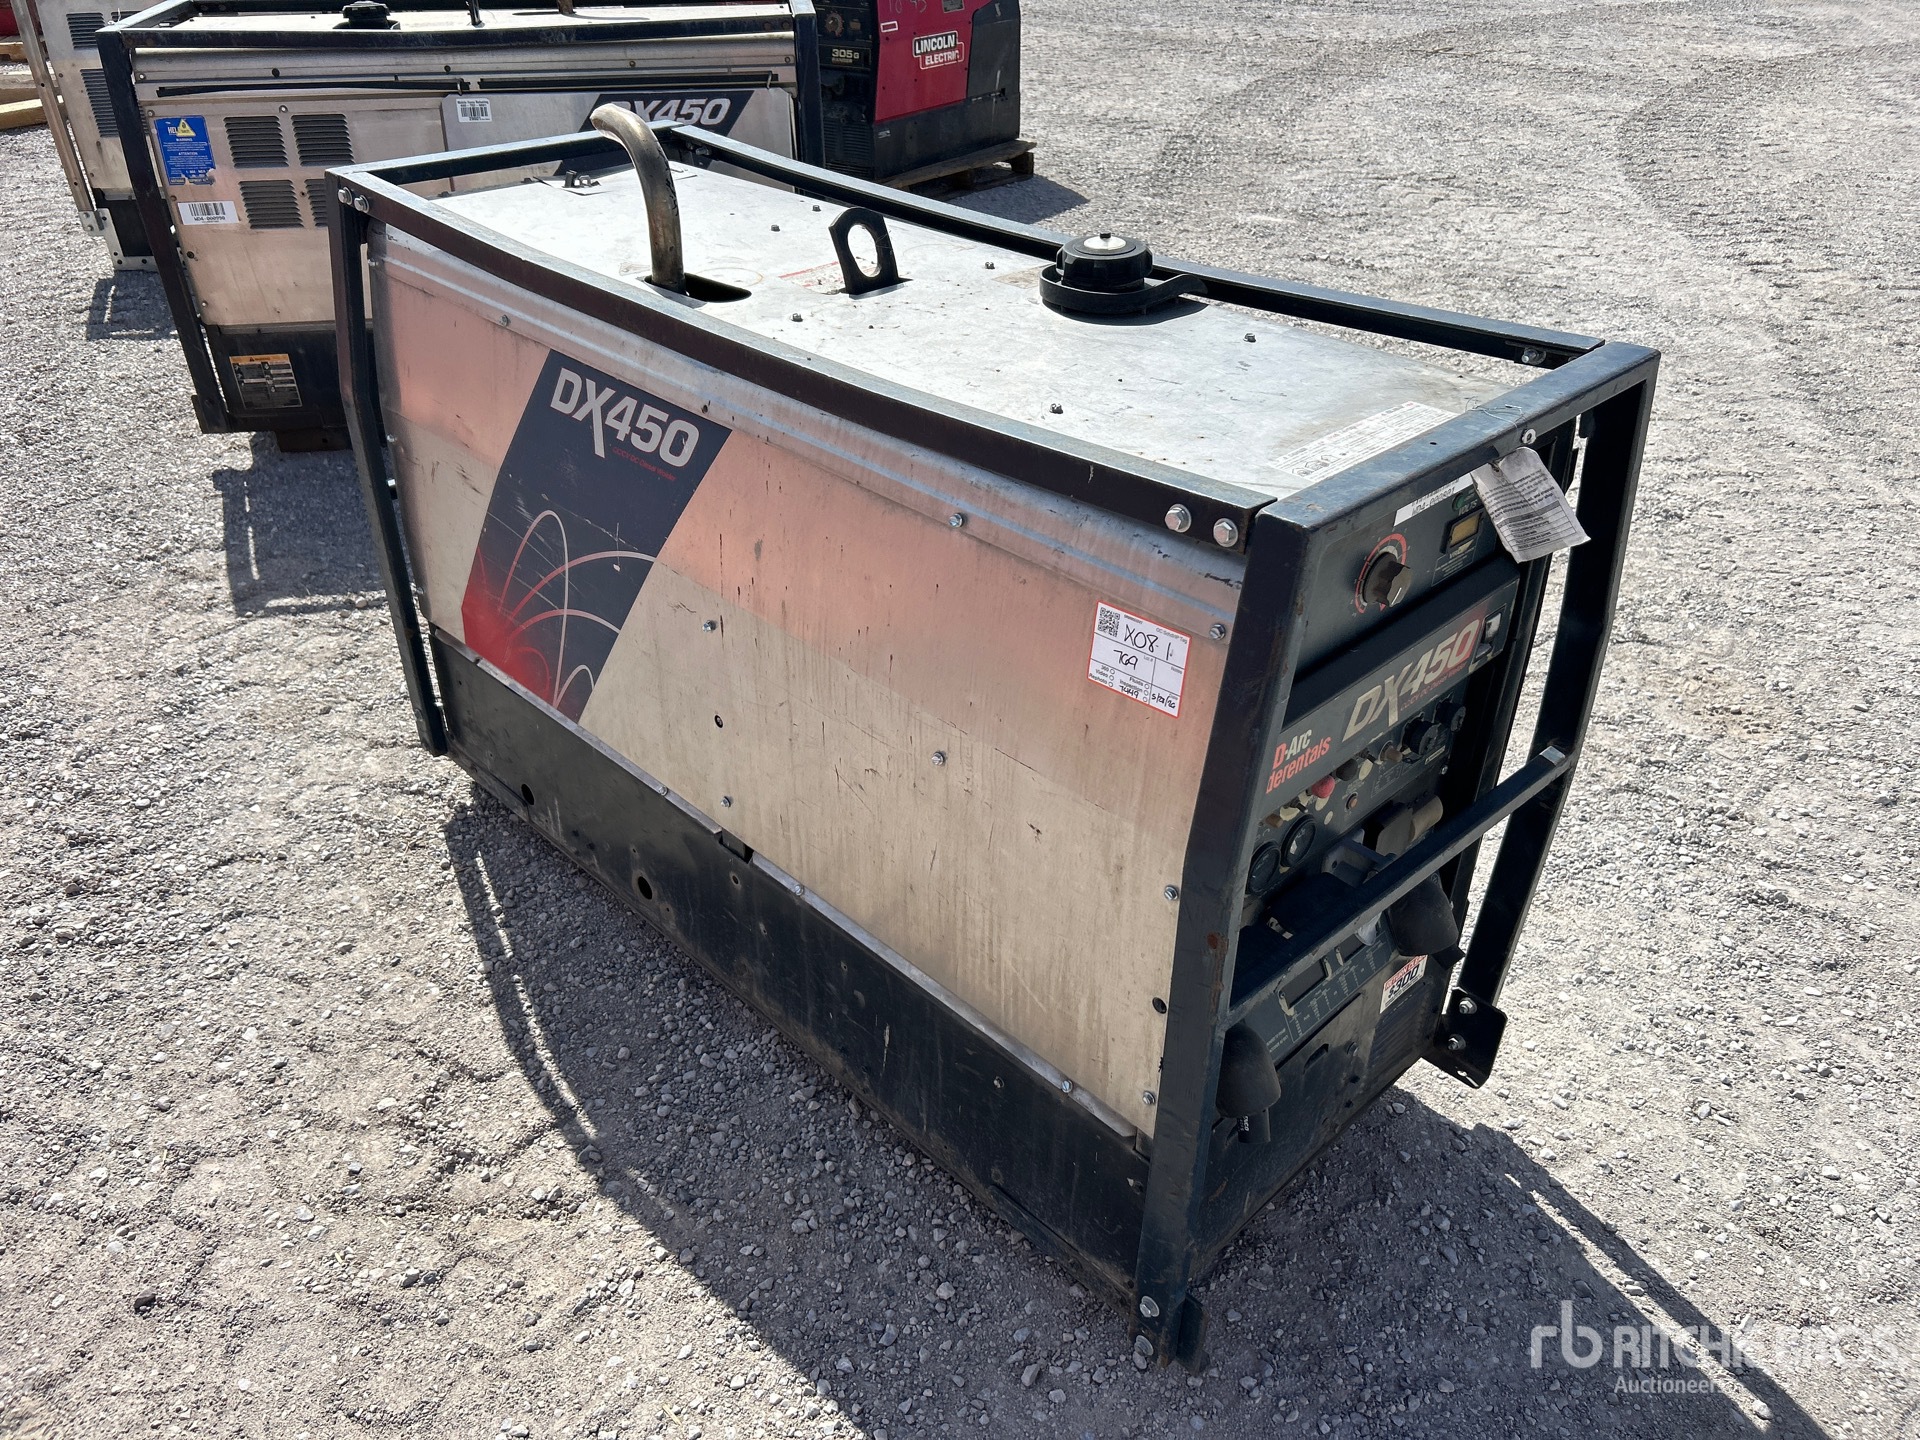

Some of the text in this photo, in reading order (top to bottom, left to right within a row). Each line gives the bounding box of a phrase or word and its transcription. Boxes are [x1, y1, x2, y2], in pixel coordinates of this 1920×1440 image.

[915, 34, 956, 54] LINCOLN
[925, 50, 960, 66] ELECTRIC
[550, 367, 700, 468] DX450
[1095, 669, 1109, 678] Video
[1342, 619, 1480, 743] DX450
[1388, 964, 1420, 998] $300
